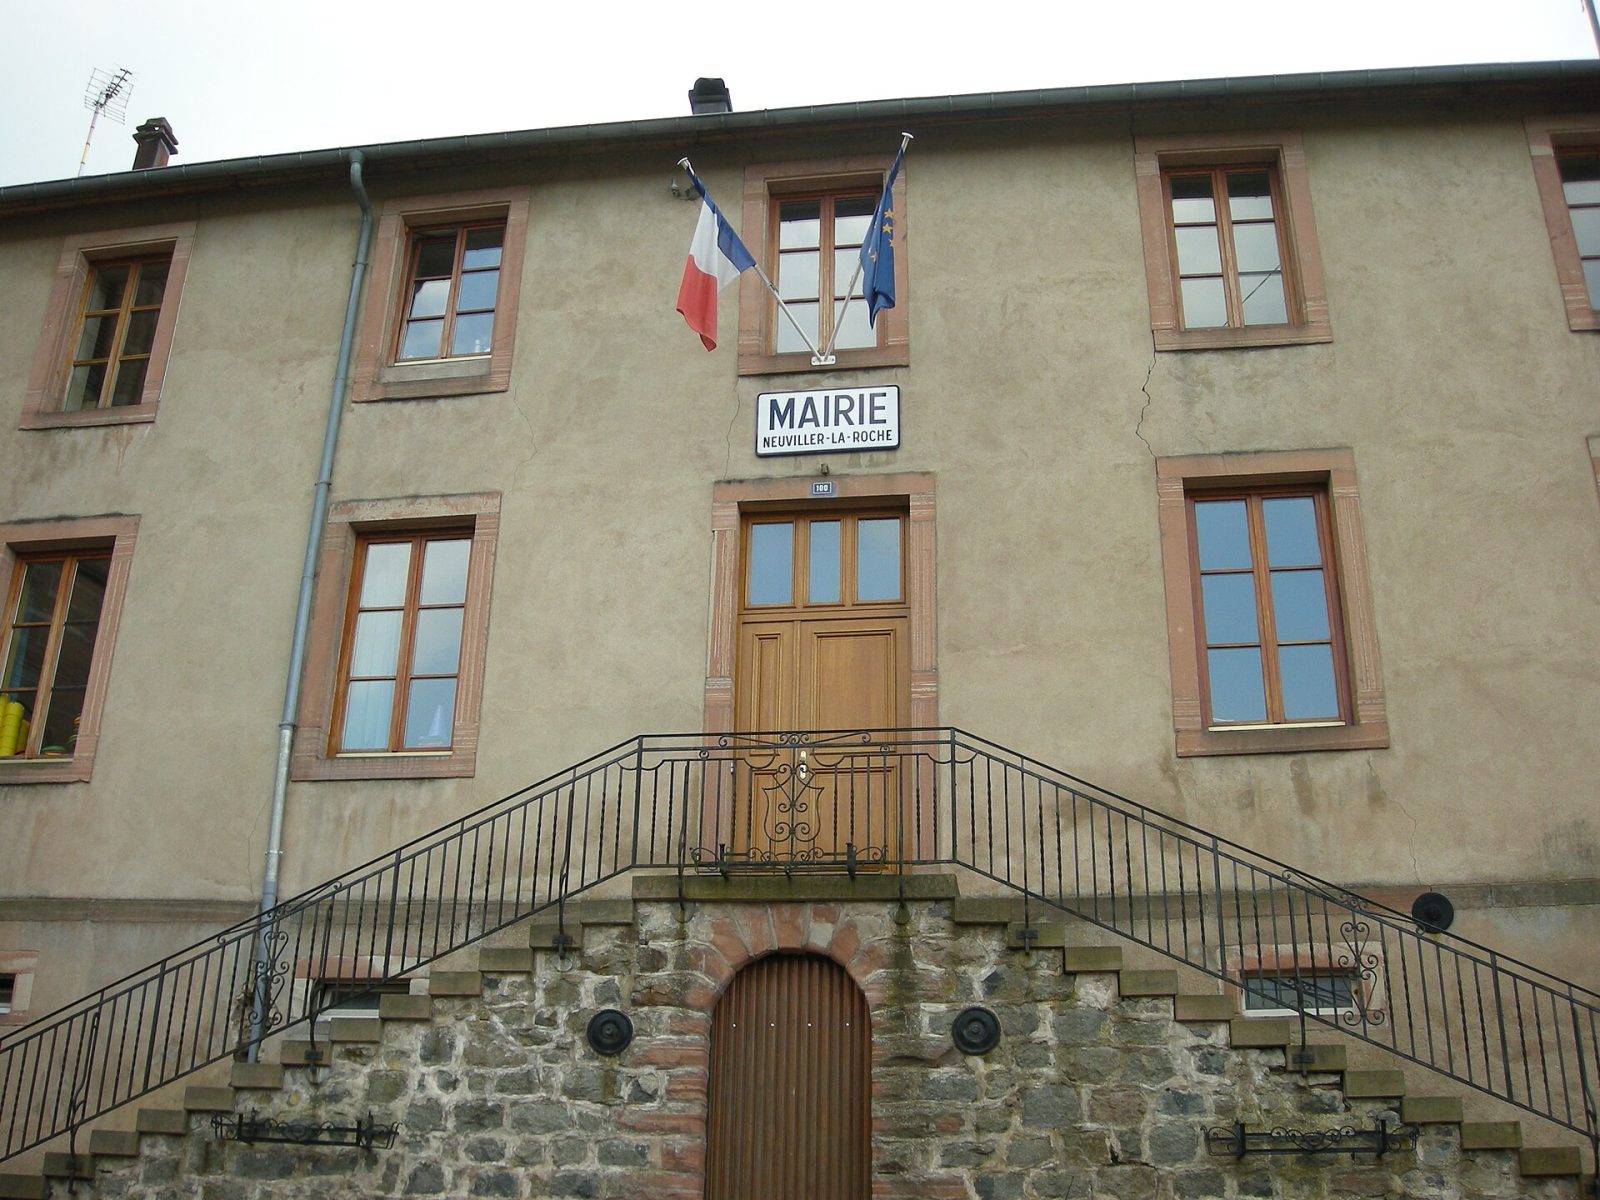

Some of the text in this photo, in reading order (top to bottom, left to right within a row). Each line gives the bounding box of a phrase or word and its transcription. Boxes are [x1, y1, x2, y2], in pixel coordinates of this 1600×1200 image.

[769, 392, 887, 431] MAIRIE
[763, 429, 892, 448] NEUVILLER-LA-ROCHE
[816, 484, 829, 492] 100
